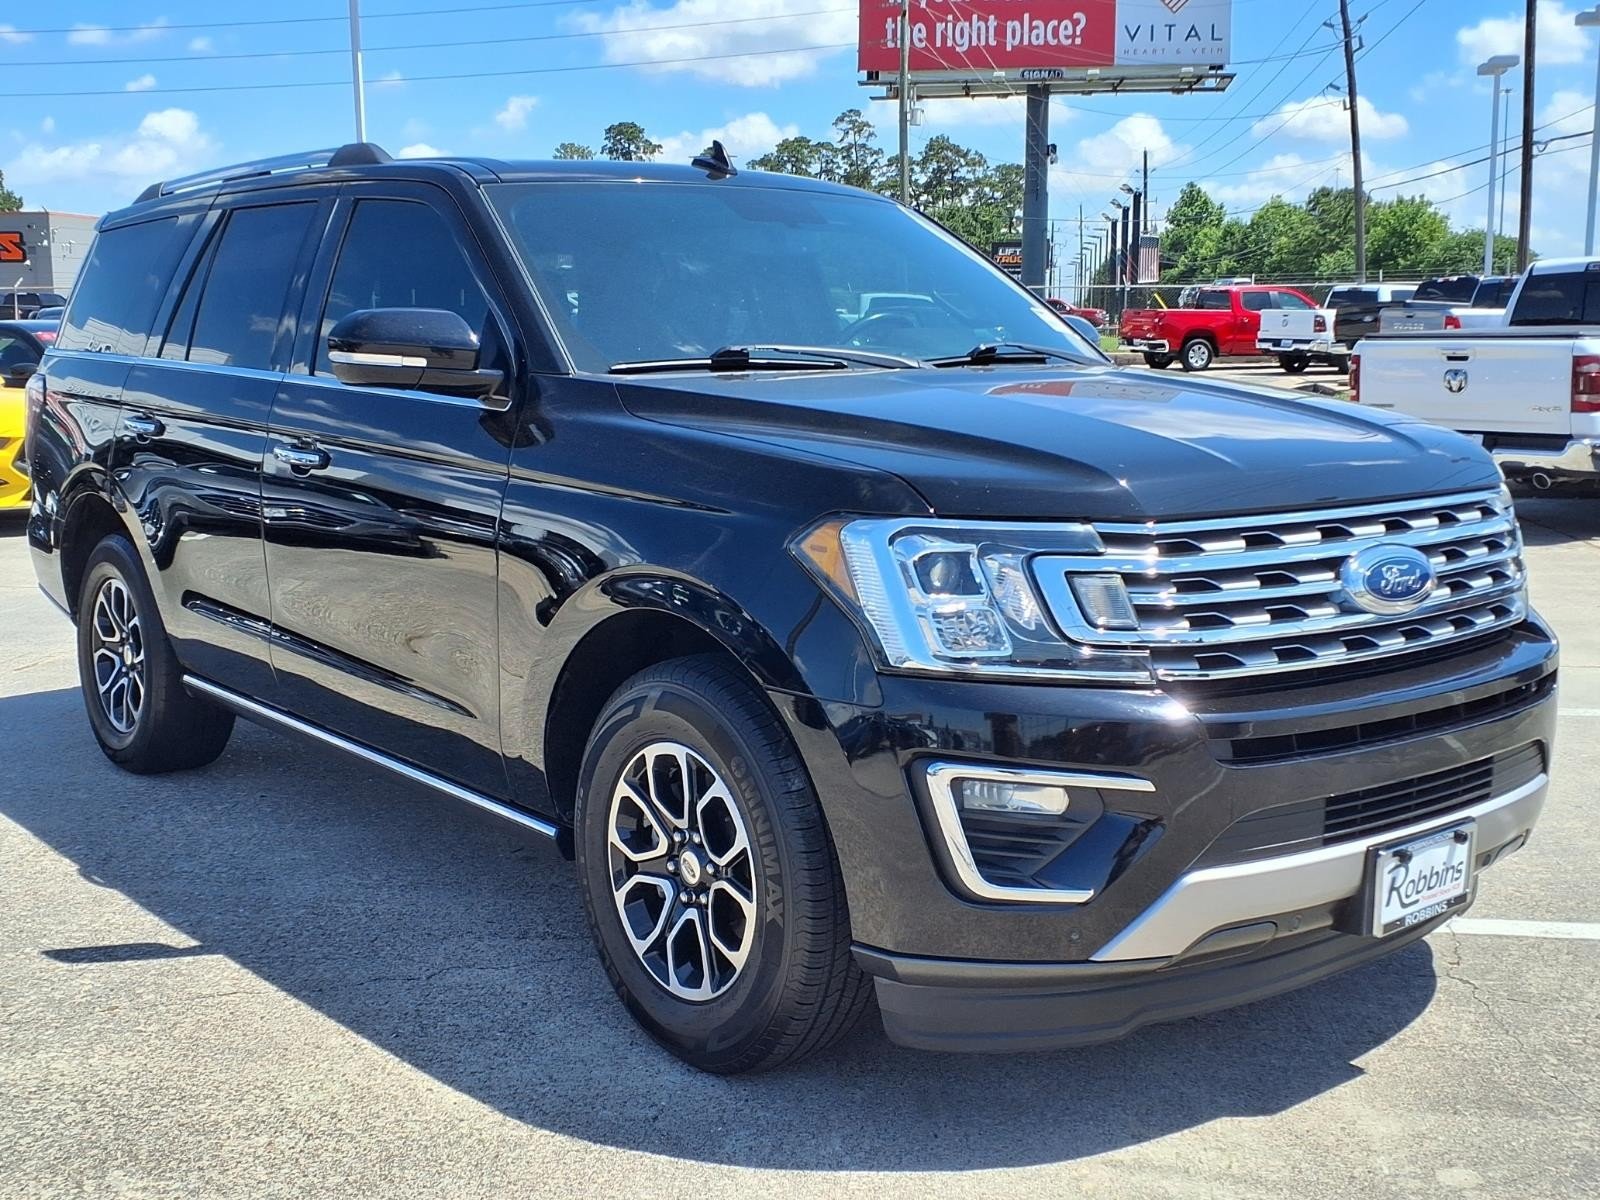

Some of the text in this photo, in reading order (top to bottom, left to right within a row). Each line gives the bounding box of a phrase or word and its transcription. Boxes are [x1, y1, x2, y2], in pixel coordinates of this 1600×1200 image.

[936, 14, 997, 52] right
[1006, 12, 1086, 51] place?
[1124, 24, 1223, 42] VITAL
[1124, 47, 1166, 55] HEART
[1192, 47, 1223, 55] VEIN
[1381, 564, 1422, 594] Ford
[1387, 861, 1464, 908] Robbins
[1404, 902, 1448, 926] ROBBINS
